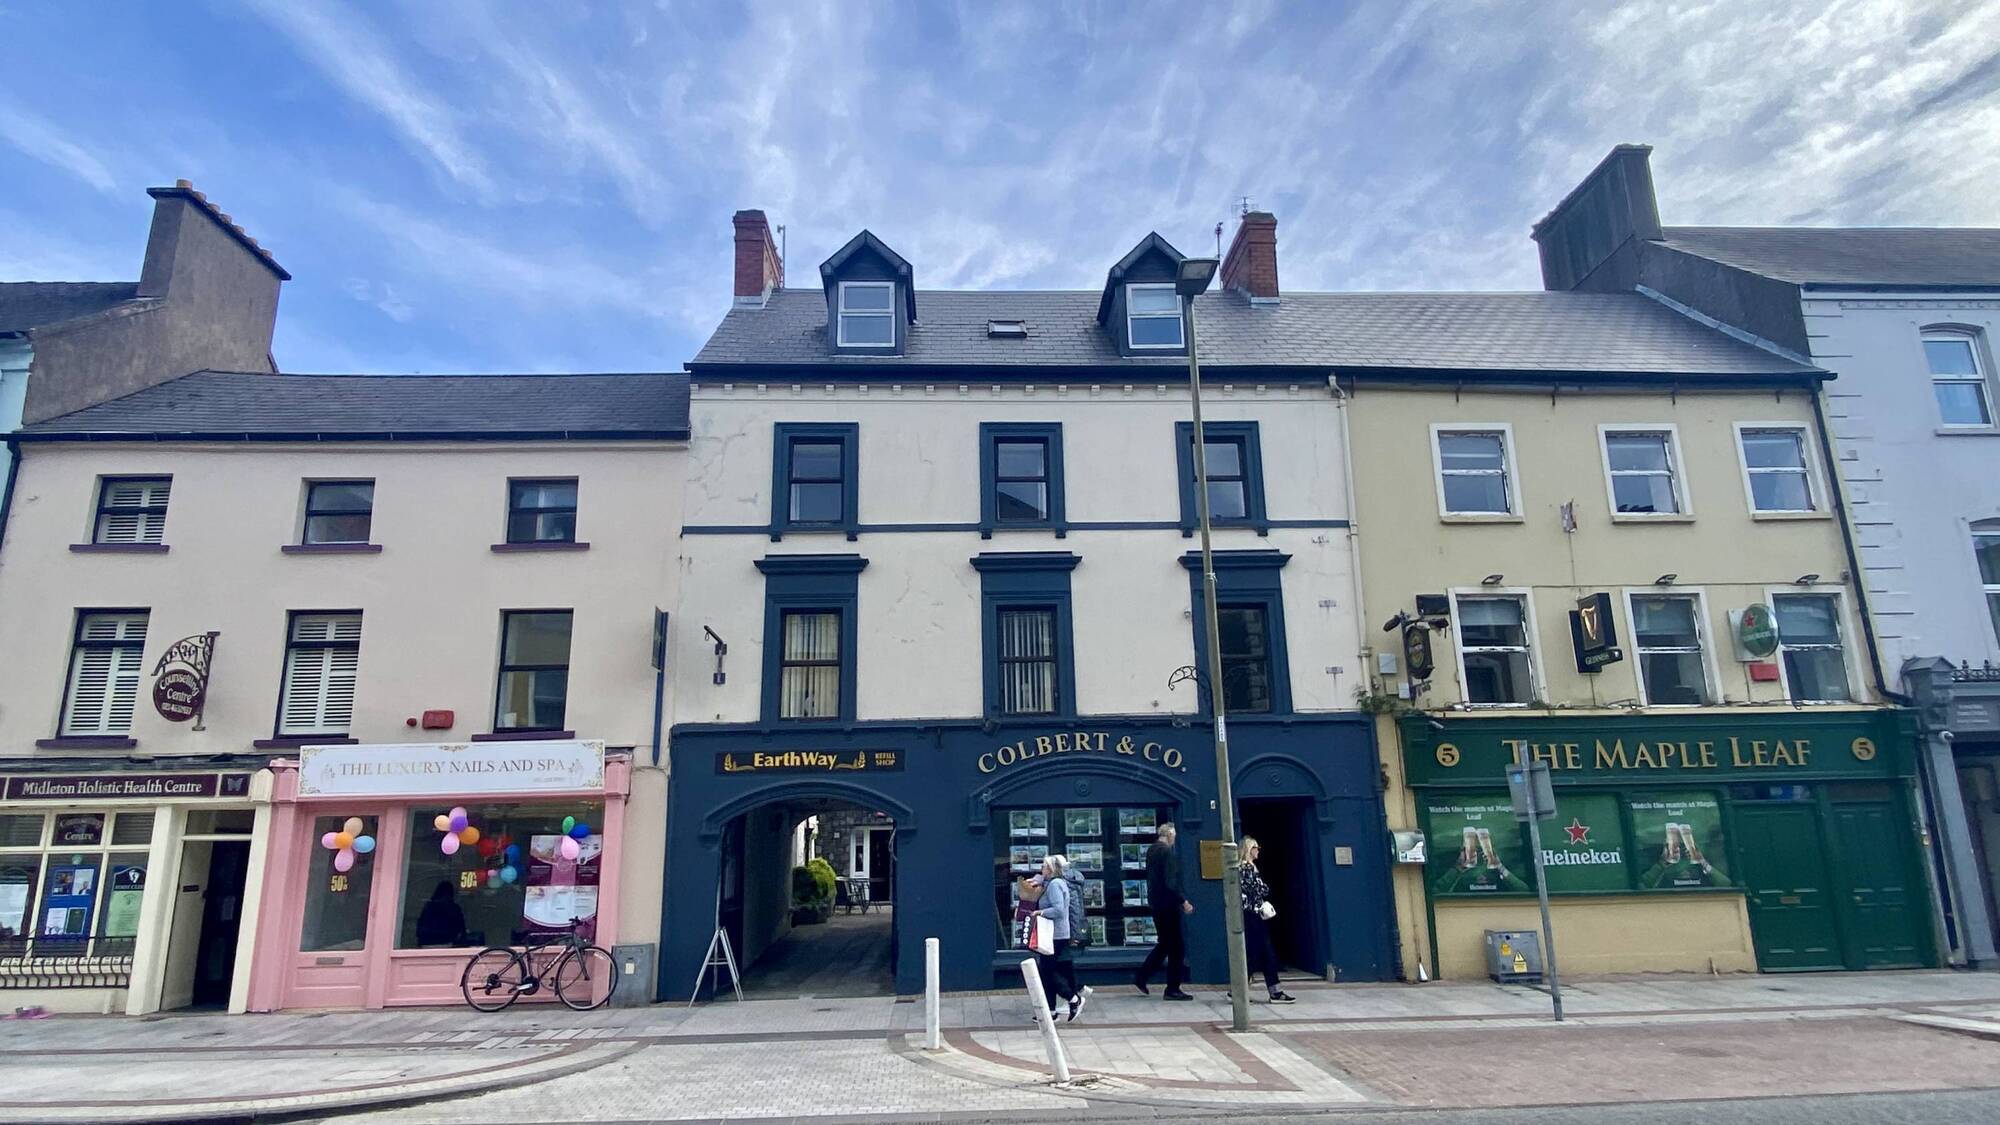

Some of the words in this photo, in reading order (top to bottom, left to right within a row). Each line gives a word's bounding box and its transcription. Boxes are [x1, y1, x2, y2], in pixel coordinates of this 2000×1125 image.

[167, 688, 192, 703] Centre
[754, 751, 837, 770] EarthWay
[978, 732, 1109, 773] COLBERT
[1116, 735, 1136, 755] &
[1143, 742, 1187, 772] CO.
[1502, 739, 1582, 769] THE
[1595, 739, 1718, 769] MAPLE
[1727, 737, 1811, 767] LEAF
[340, 763, 375, 776] THE
[377, 761, 446, 776] LUXURY
[450, 760, 495, 773] NAILS
[499, 759, 533, 772] AND
[537, 759, 565, 772] SPA
[22, 780, 75, 795] Midleton
[77, 780, 122, 795] Holistic
[124, 779, 162, 793] Health
[164, 779, 202, 793] Centre
[1542, 849, 1621, 866] Heineken
